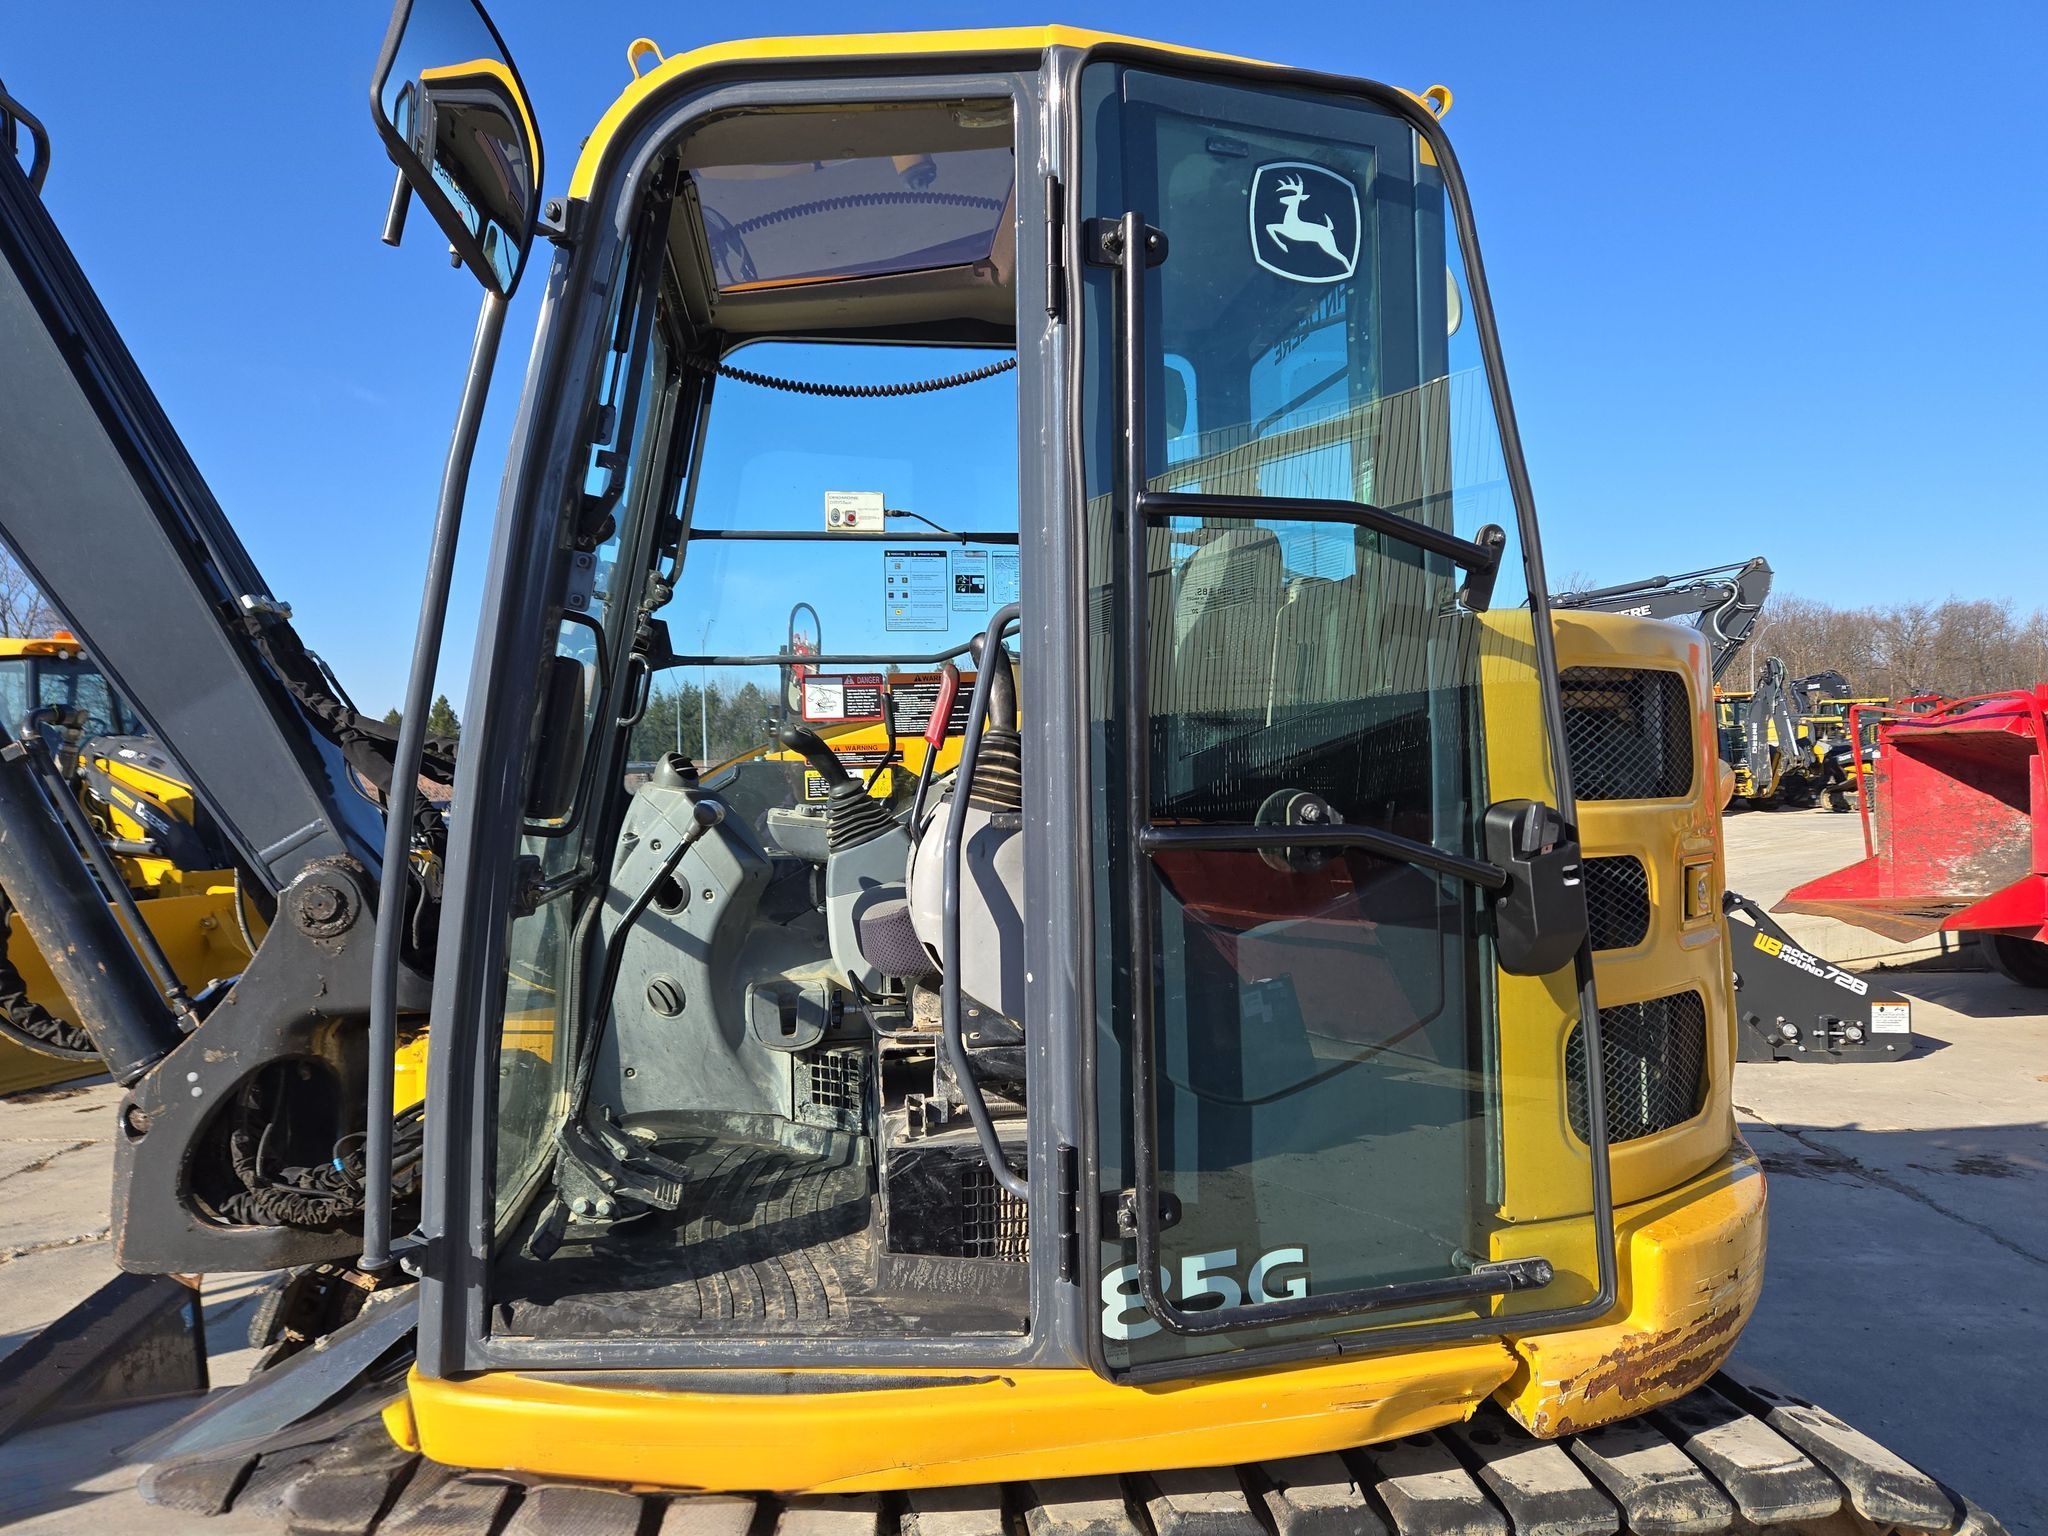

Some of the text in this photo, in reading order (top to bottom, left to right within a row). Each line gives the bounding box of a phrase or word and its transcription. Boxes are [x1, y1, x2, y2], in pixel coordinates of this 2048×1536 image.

[856, 676, 880, 684] DANGER
[844, 744, 878, 752] WARNING
[1777, 952, 1825, 978] HOUND
[1781, 944, 1818, 966] ROCK
[1101, 1247, 1308, 1341] 85G
